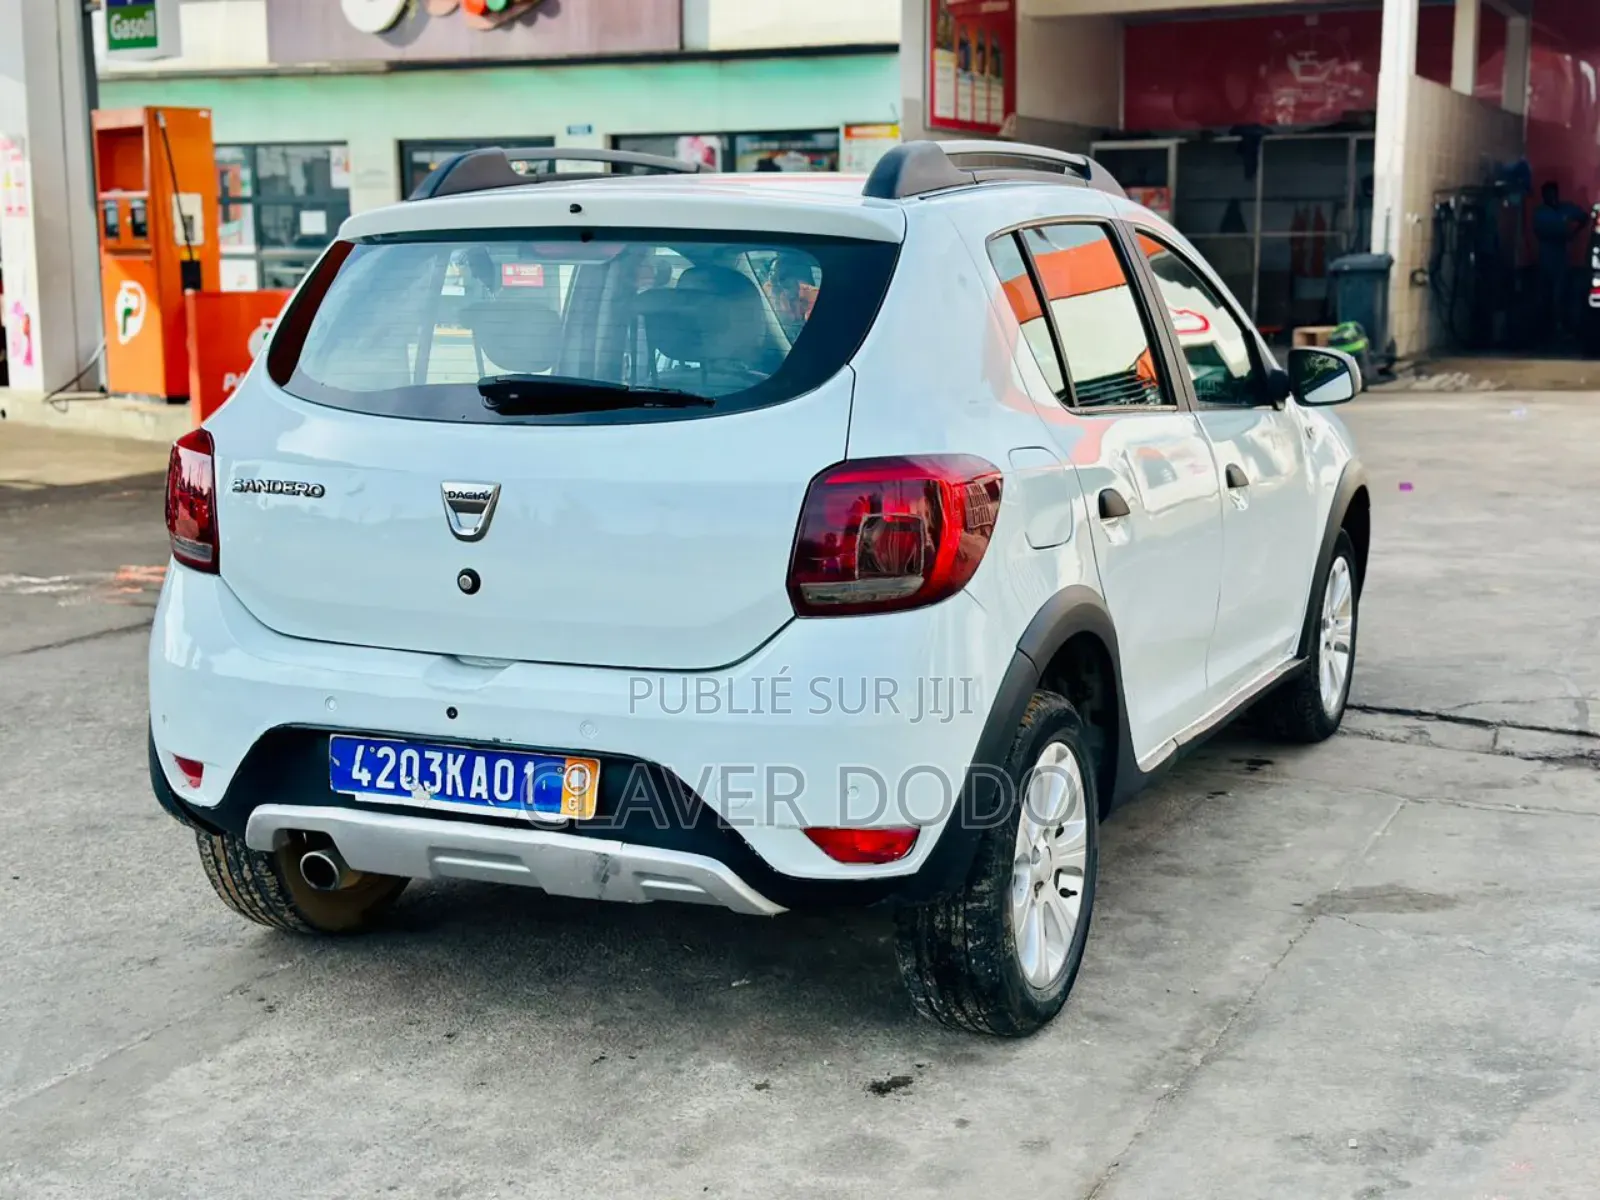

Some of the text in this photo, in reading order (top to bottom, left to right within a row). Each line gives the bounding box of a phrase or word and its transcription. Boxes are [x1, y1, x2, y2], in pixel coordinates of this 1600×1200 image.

[111, 10, 156, 40] Gasoil
[232, 479, 325, 498] SANDERO
[447, 490, 490, 500] DACIA
